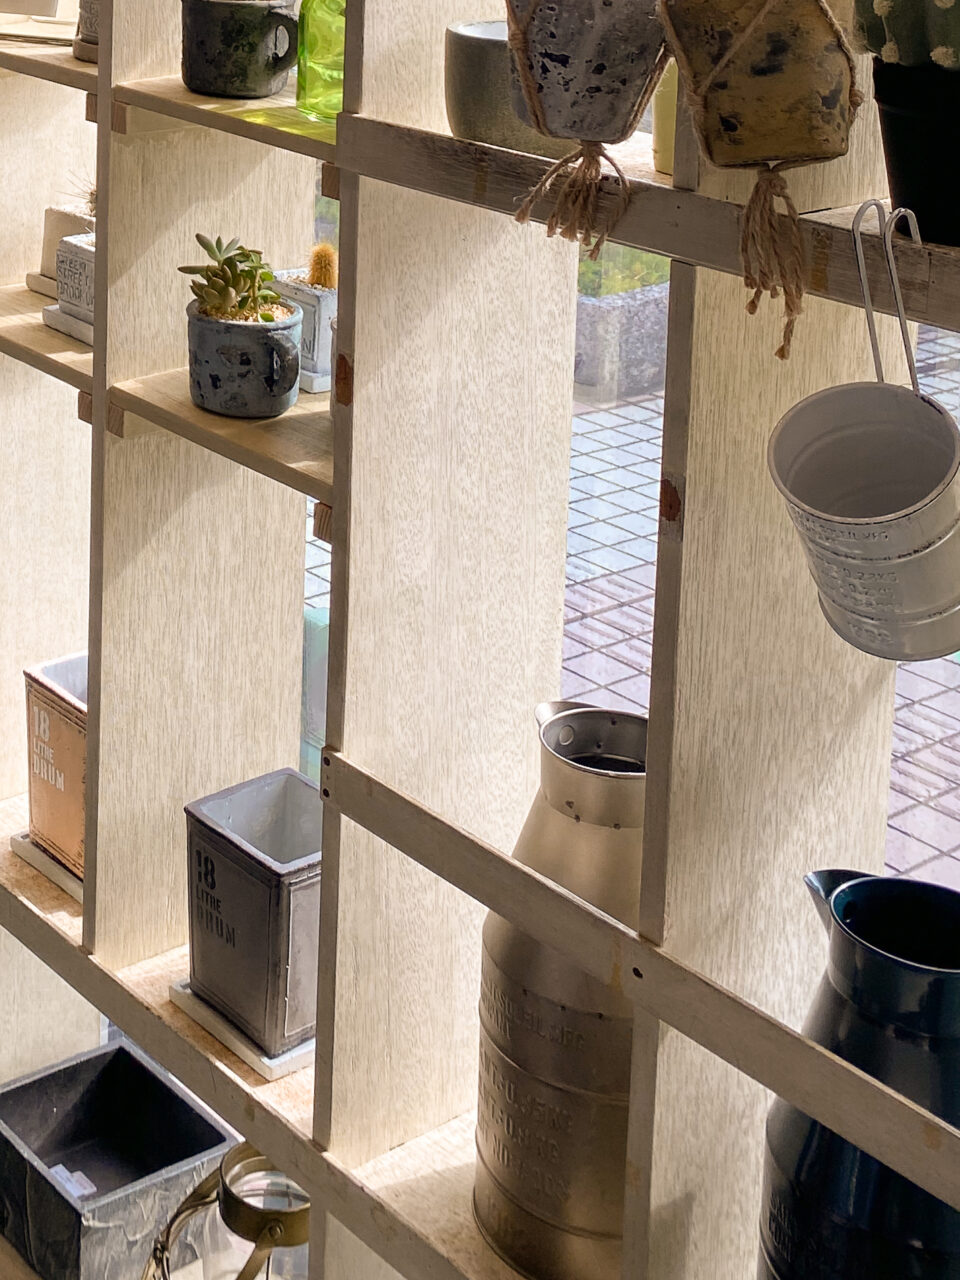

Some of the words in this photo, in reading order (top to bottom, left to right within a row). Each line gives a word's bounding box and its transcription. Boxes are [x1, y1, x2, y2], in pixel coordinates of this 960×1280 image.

[33, 705, 50, 742] 18
[33, 753, 65, 792] DRUM
[196, 849, 217, 890] 18
[197, 901, 236, 949] DRUM
